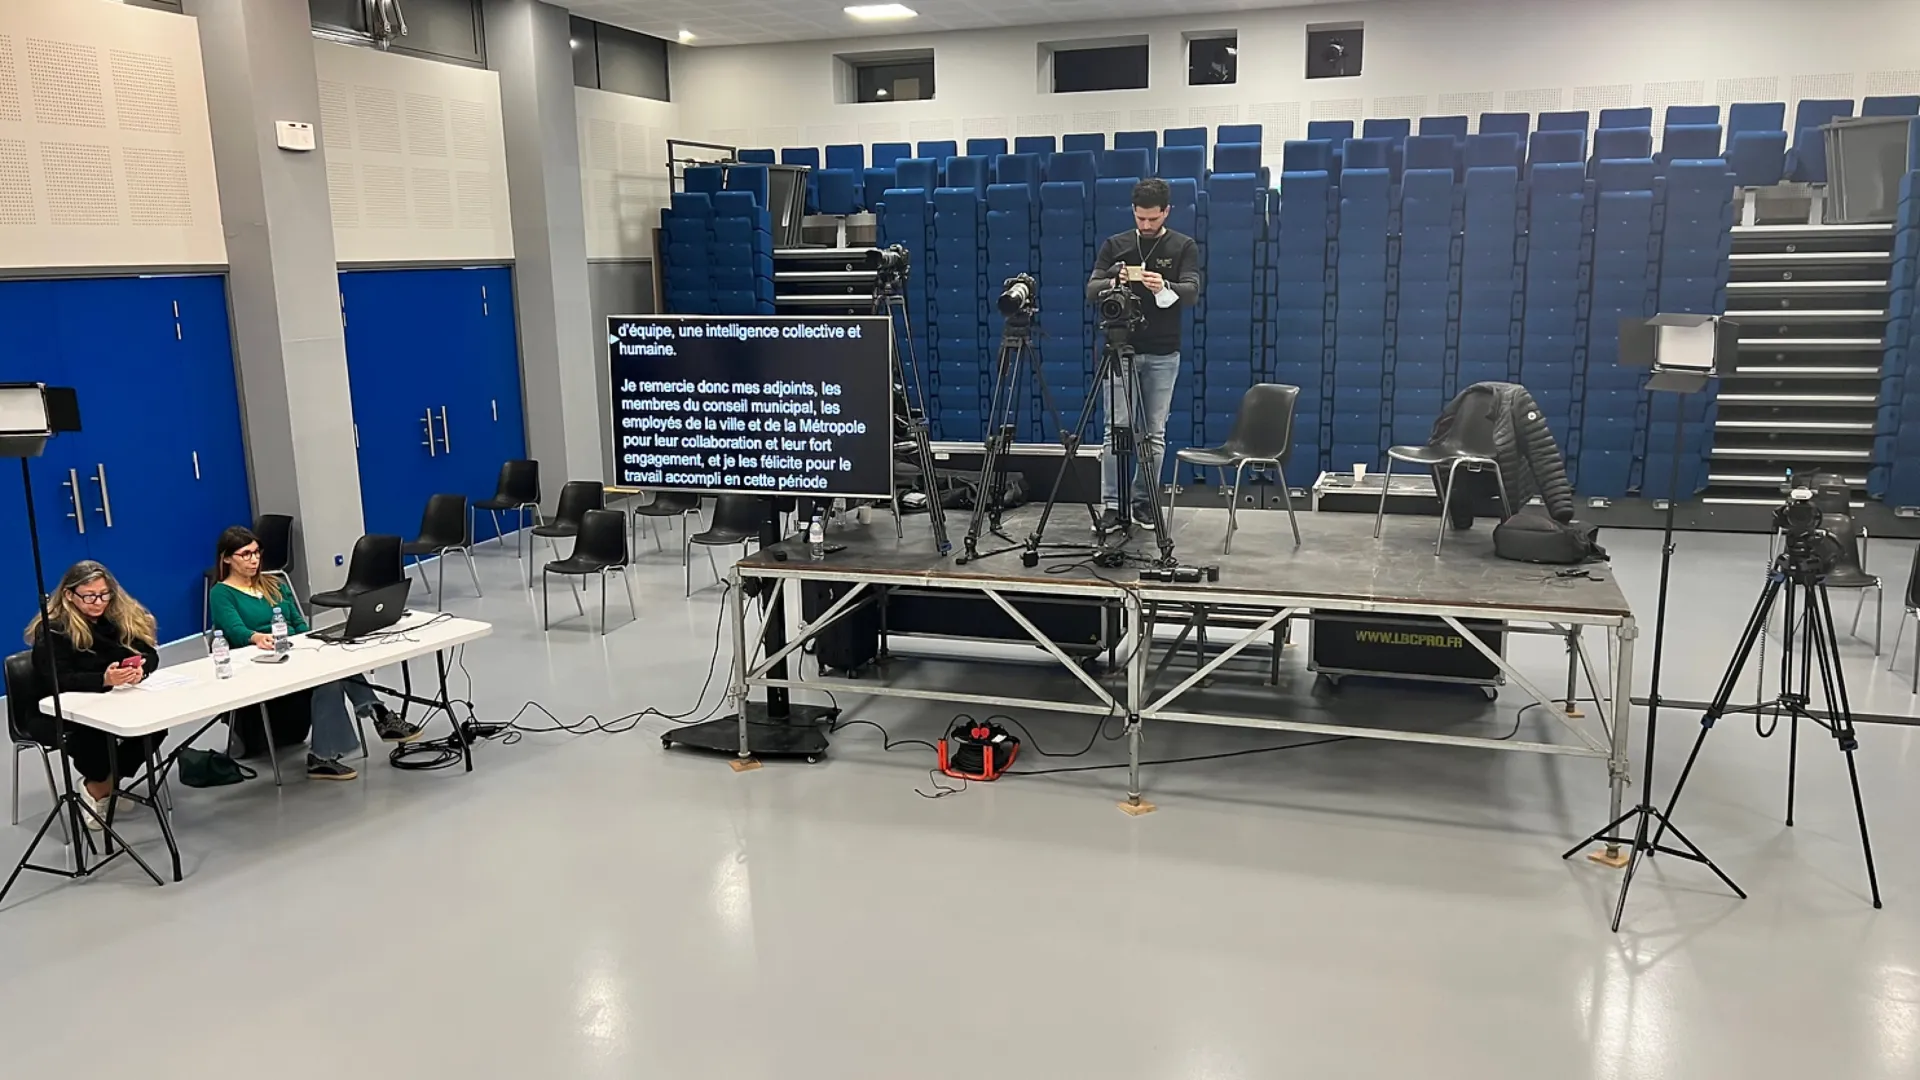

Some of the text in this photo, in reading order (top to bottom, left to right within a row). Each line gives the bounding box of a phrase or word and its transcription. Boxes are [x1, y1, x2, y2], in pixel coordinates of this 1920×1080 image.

[618, 324, 861, 340] d'équipe, une intelligence collective et
[619, 342, 677, 356] humaine.
[621, 379, 841, 397] Je remercie donc mes adjoints, les
[622, 399, 840, 416] membres du conseil municipal, les
[622, 416, 866, 437] employés de la ville et de la Métropole
[623, 435, 832, 452] pour leur collaboration et leur fort
[624, 454, 851, 472] engagement, et je les félicite pour le
[624, 470, 828, 490] travail accompli en cette période
[1356, 630, 1463, 648] WWW.LBCPRO.FR
